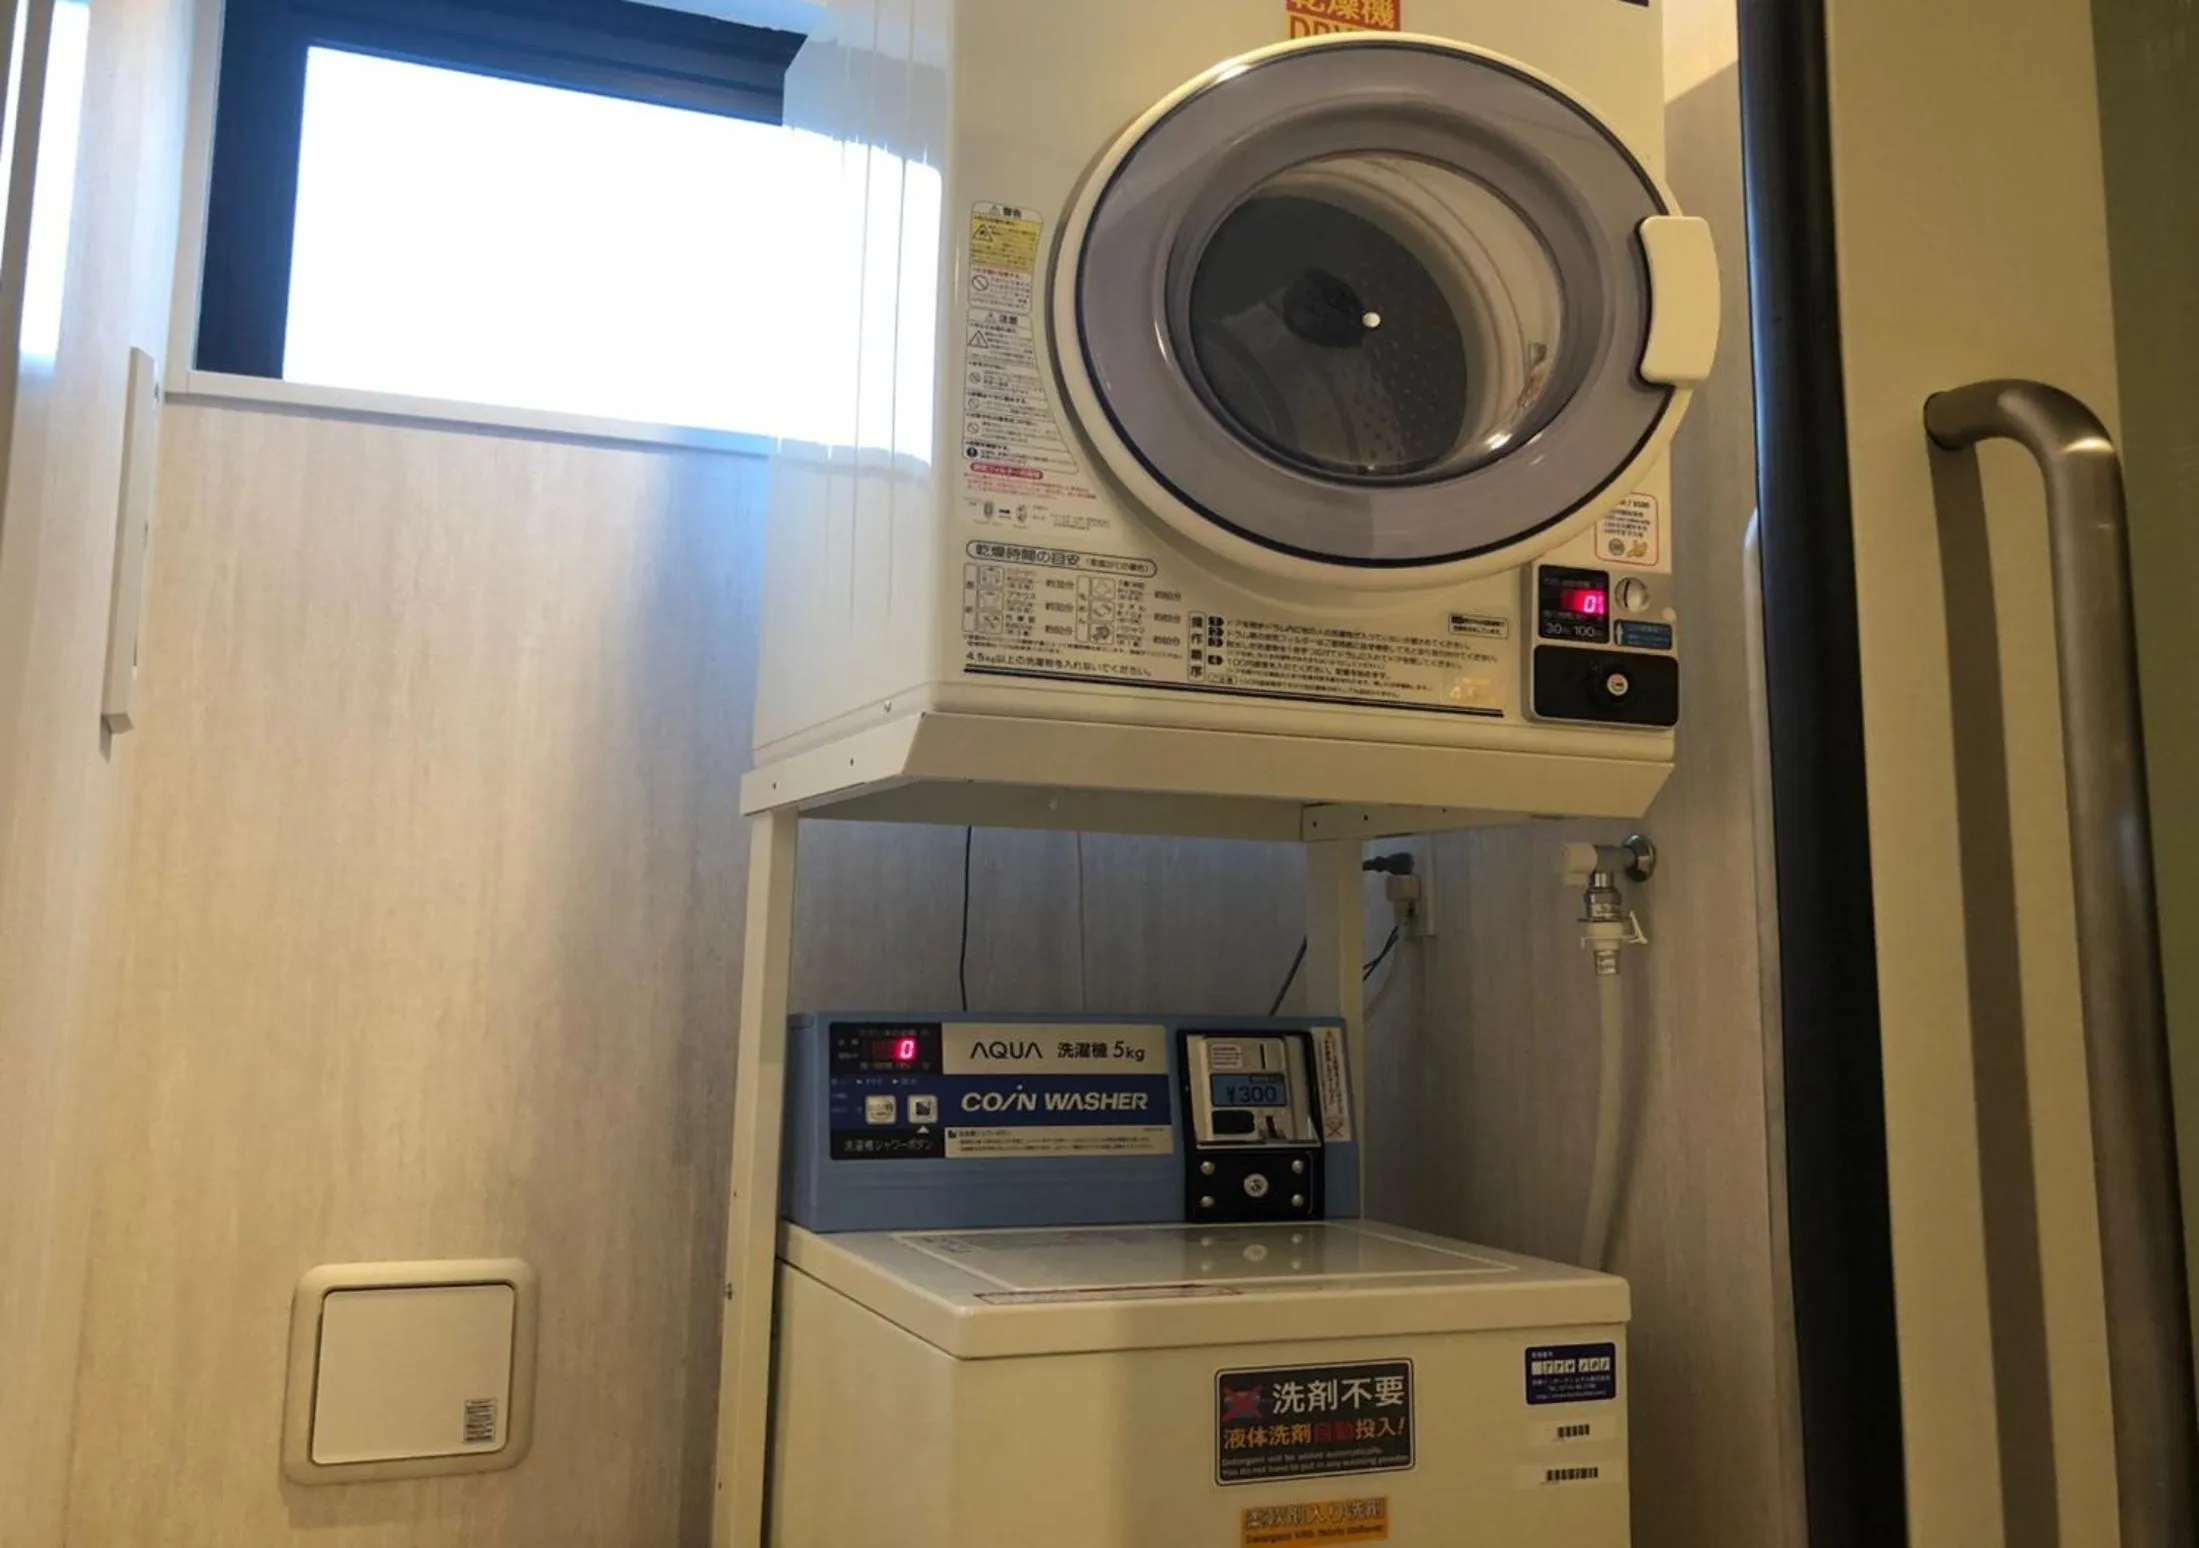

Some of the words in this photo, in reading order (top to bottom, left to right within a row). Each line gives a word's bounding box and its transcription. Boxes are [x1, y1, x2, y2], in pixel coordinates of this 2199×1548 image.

[900, 1039, 915, 1060] 0
[970, 1042, 1043, 1059] AQUA
[1057, 1041, 1108, 1059] 洗濯機
[1113, 1041, 1145, 1062] 5kg
[1045, 1092, 1148, 1111] WASHER
[1272, 1375, 1404, 1414] 洗剤不要
